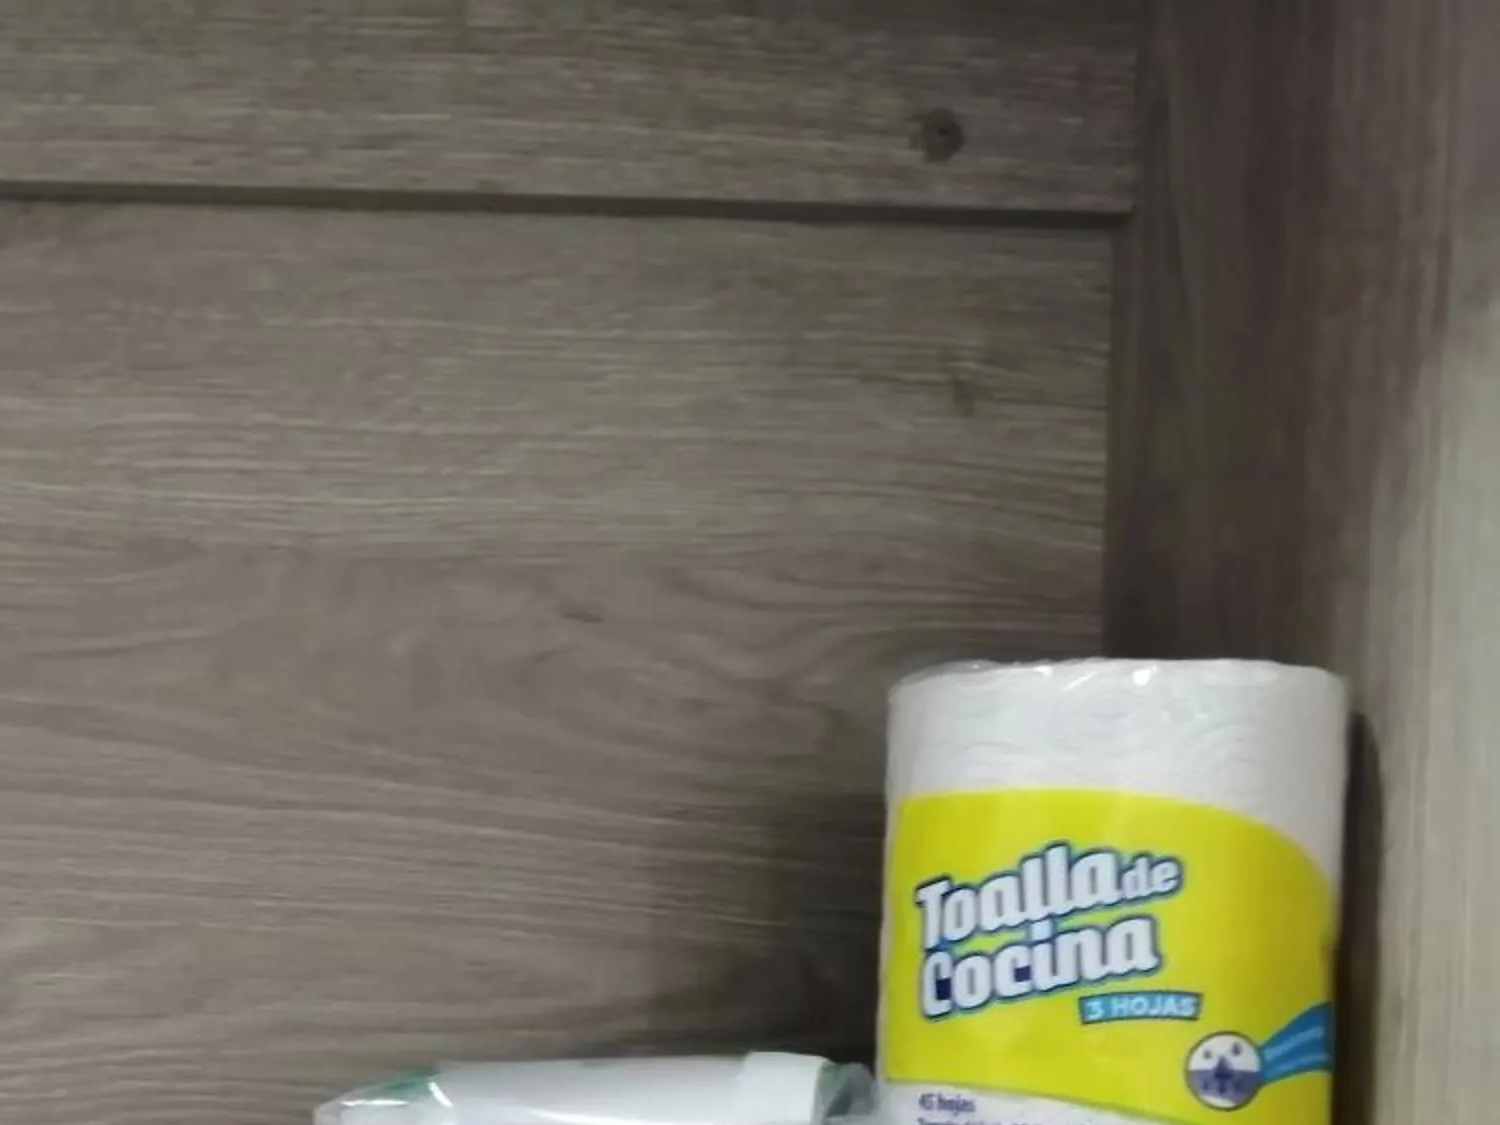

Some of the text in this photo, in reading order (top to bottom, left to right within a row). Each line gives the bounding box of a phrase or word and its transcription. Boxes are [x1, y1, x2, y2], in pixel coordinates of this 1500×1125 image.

[916, 842, 1182, 949] Toalla de
[922, 915, 1162, 1018] Cocina
[1111, 996, 1198, 1017] HOJAS
